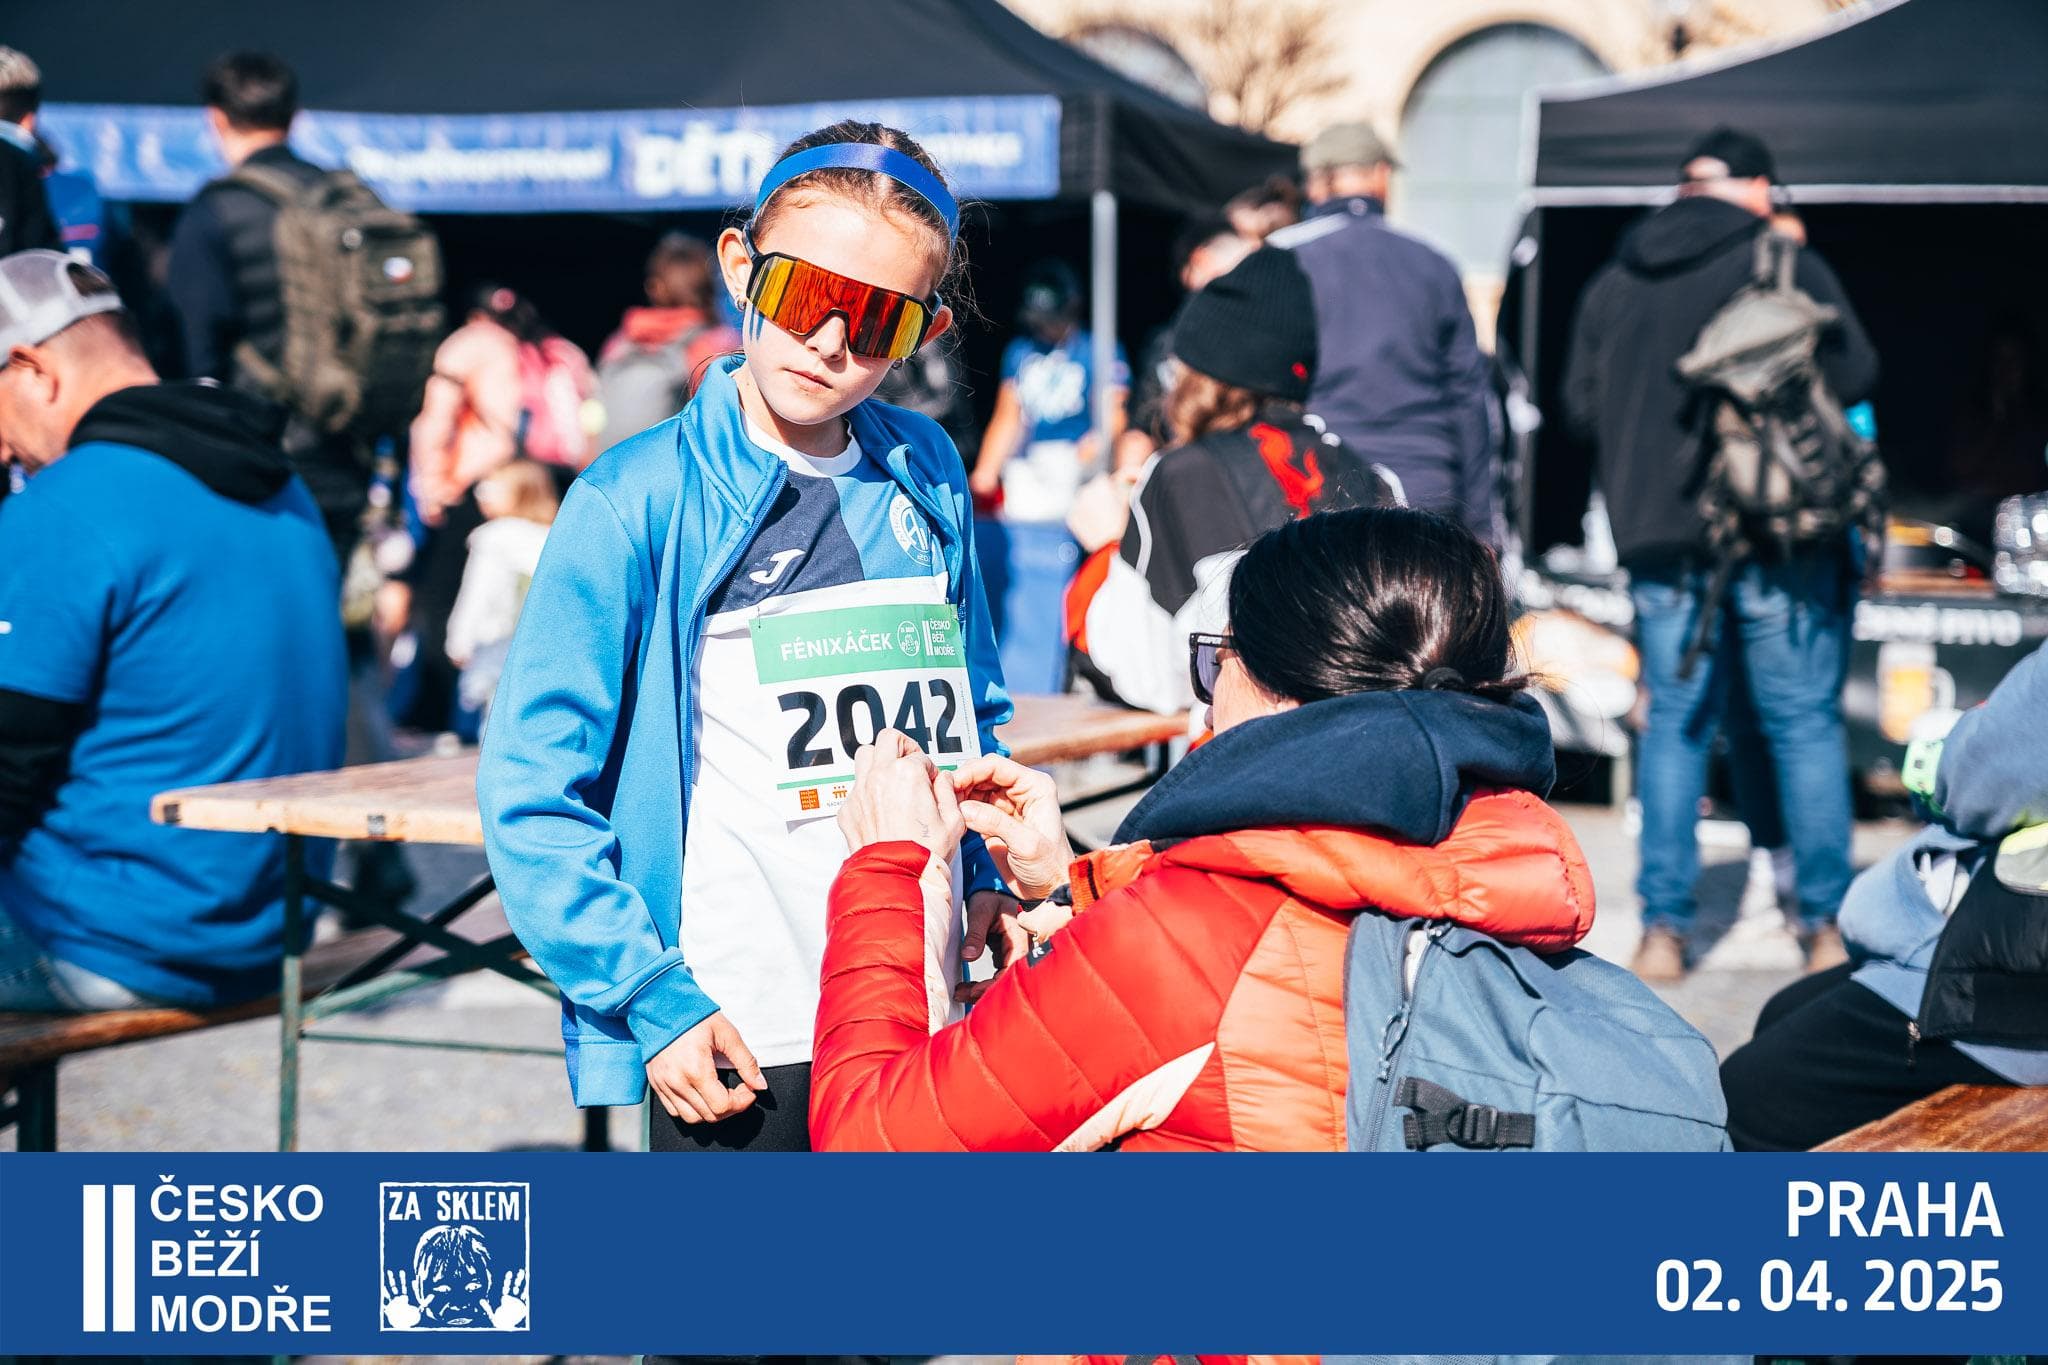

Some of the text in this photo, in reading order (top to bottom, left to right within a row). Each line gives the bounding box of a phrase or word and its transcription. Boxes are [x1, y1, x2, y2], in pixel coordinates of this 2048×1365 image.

[930, 618, 951, 631] ČESKO
[932, 631, 946, 643] BĚŽÍ
[780, 629, 894, 662] FÉNIXÁČEK
[934, 644, 956, 656] MODŘE
[777, 679, 963, 770] 2042
